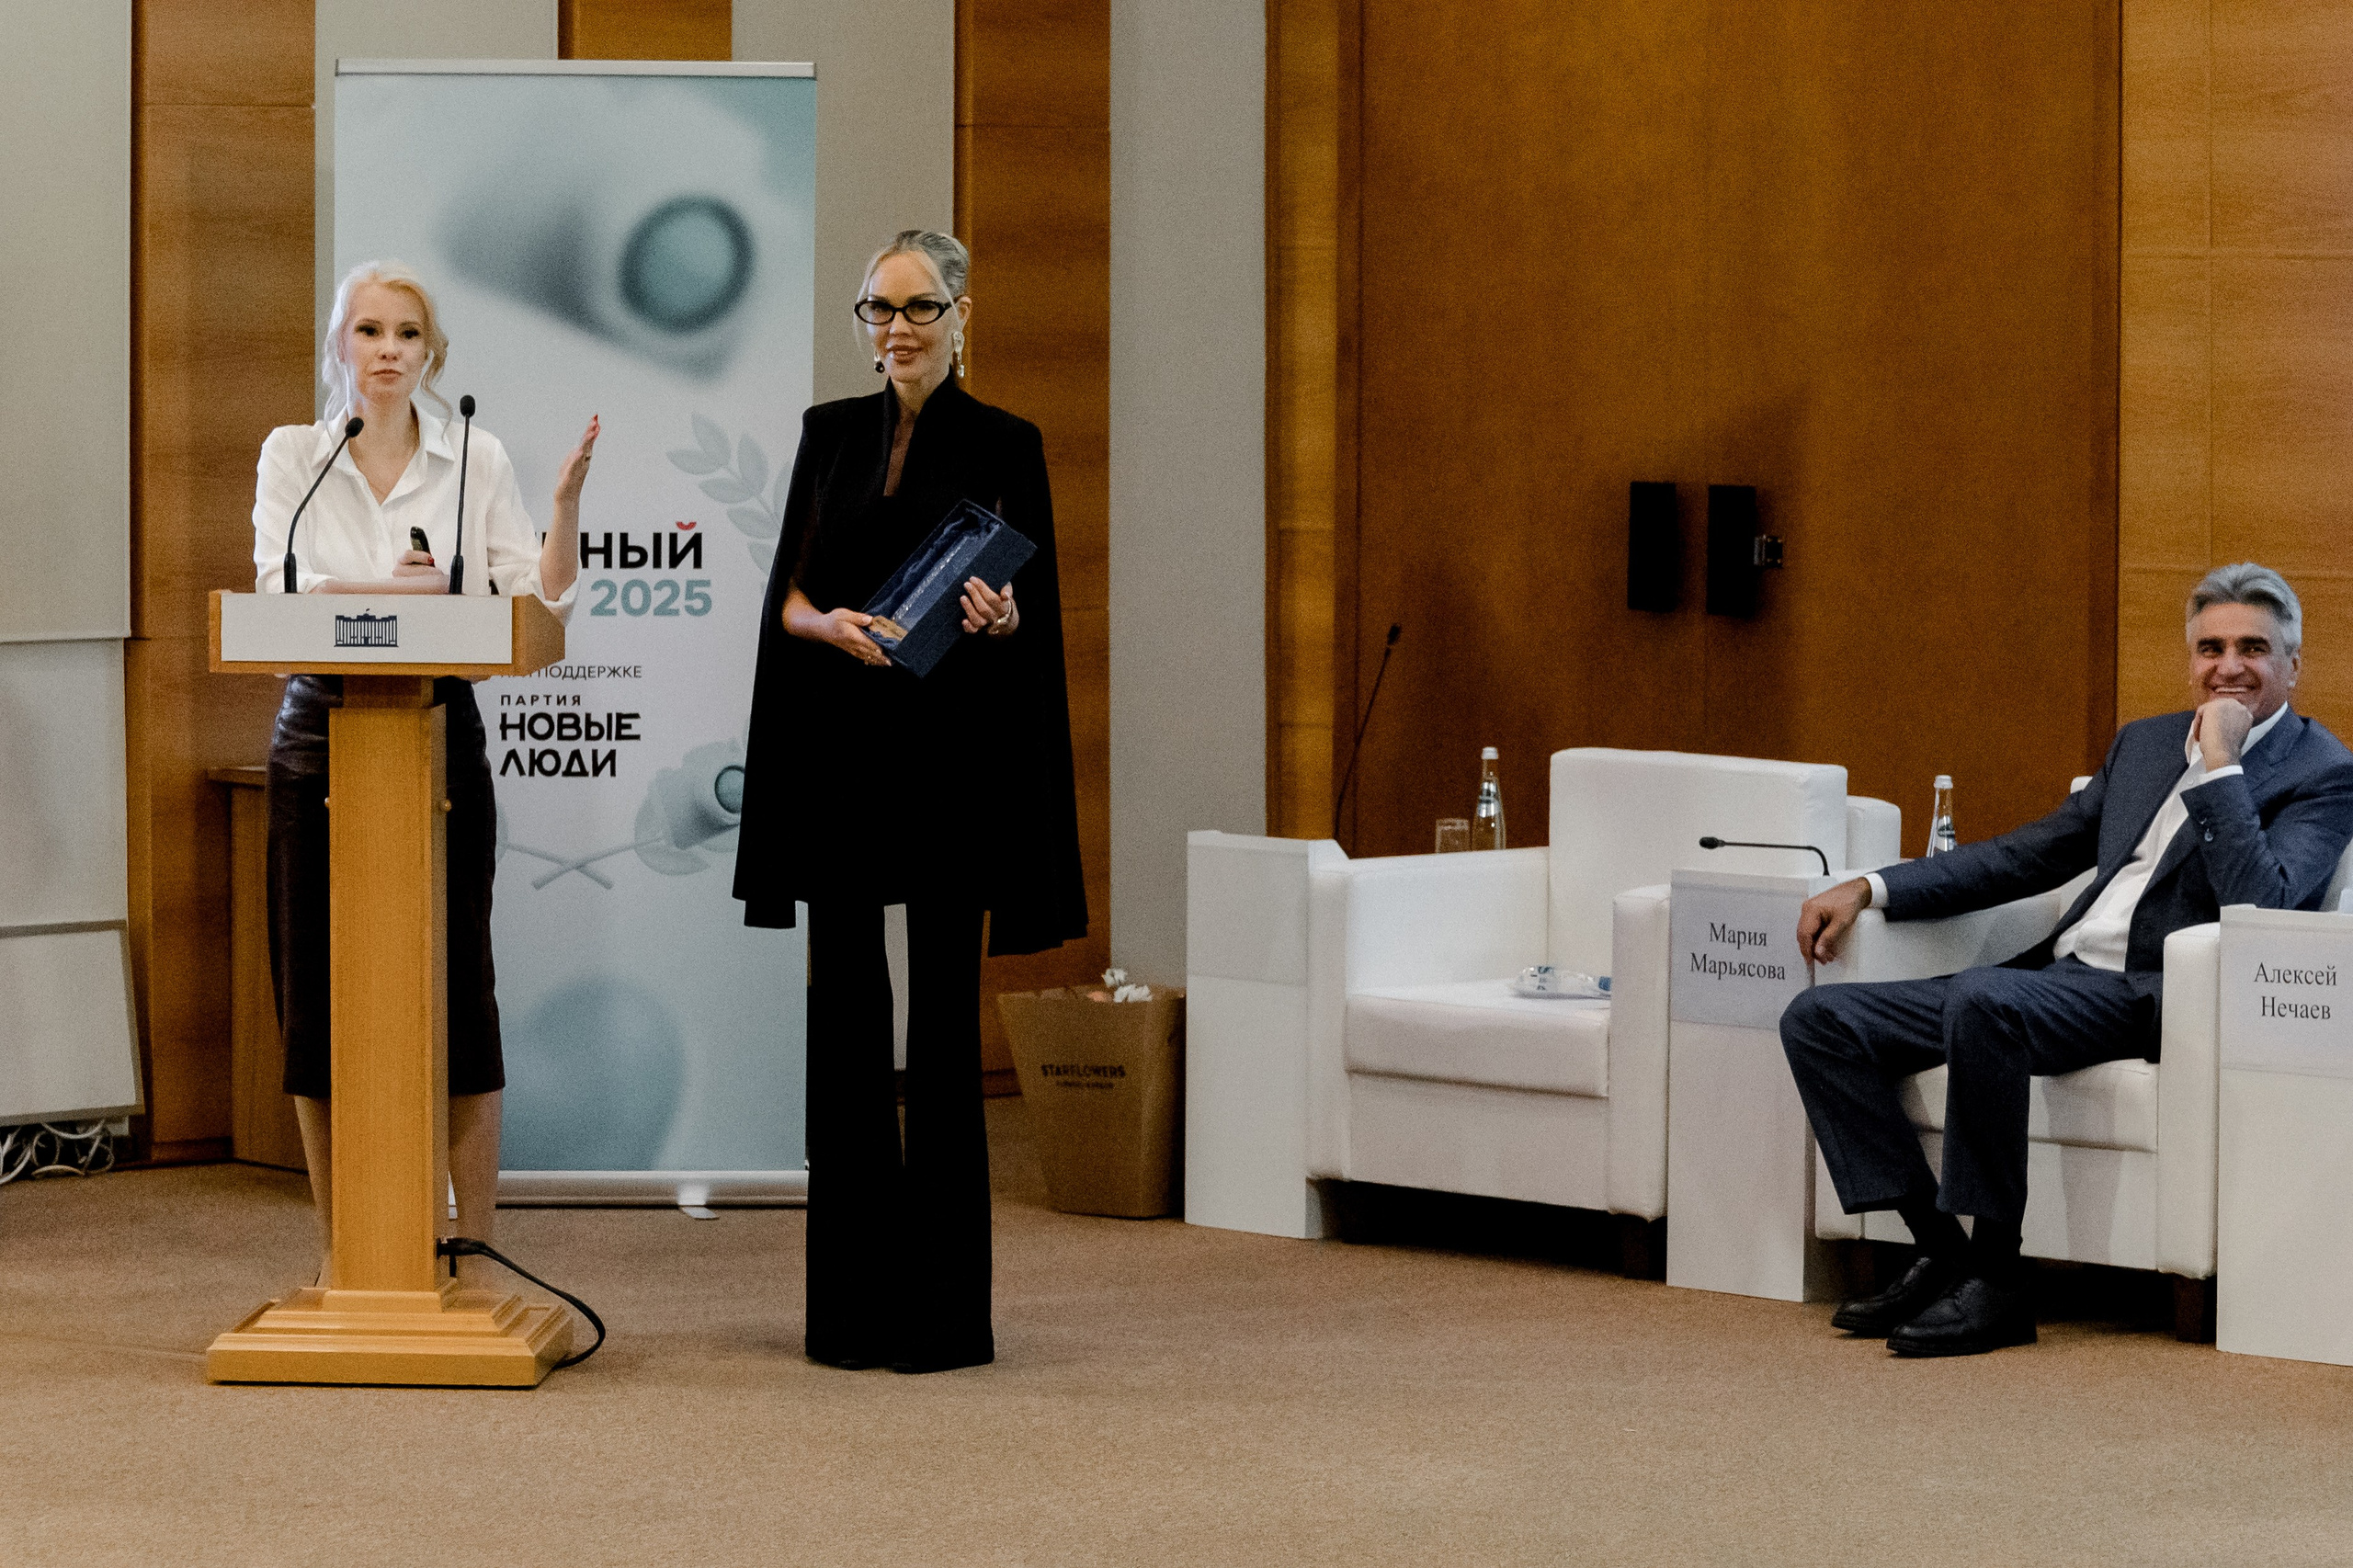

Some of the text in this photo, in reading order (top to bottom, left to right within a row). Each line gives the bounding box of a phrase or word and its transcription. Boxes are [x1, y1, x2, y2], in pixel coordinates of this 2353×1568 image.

[541, 521, 703, 569] НЫЙ
[589, 578, 713, 618] 2025
[538, 665, 642, 680] ПОДДЕРЖКЕ
[500, 694, 581, 707] ПАРТИЯ
[499, 711, 642, 742] НОВЫЕ
[499, 747, 617, 778] ЛЮДИ
[1709, 922, 1768, 950] Мария
[1689, 952, 1786, 981] Марьясова
[2254, 961, 2337, 986] Алексей
[2261, 995, 2331, 1020] Нечаев
